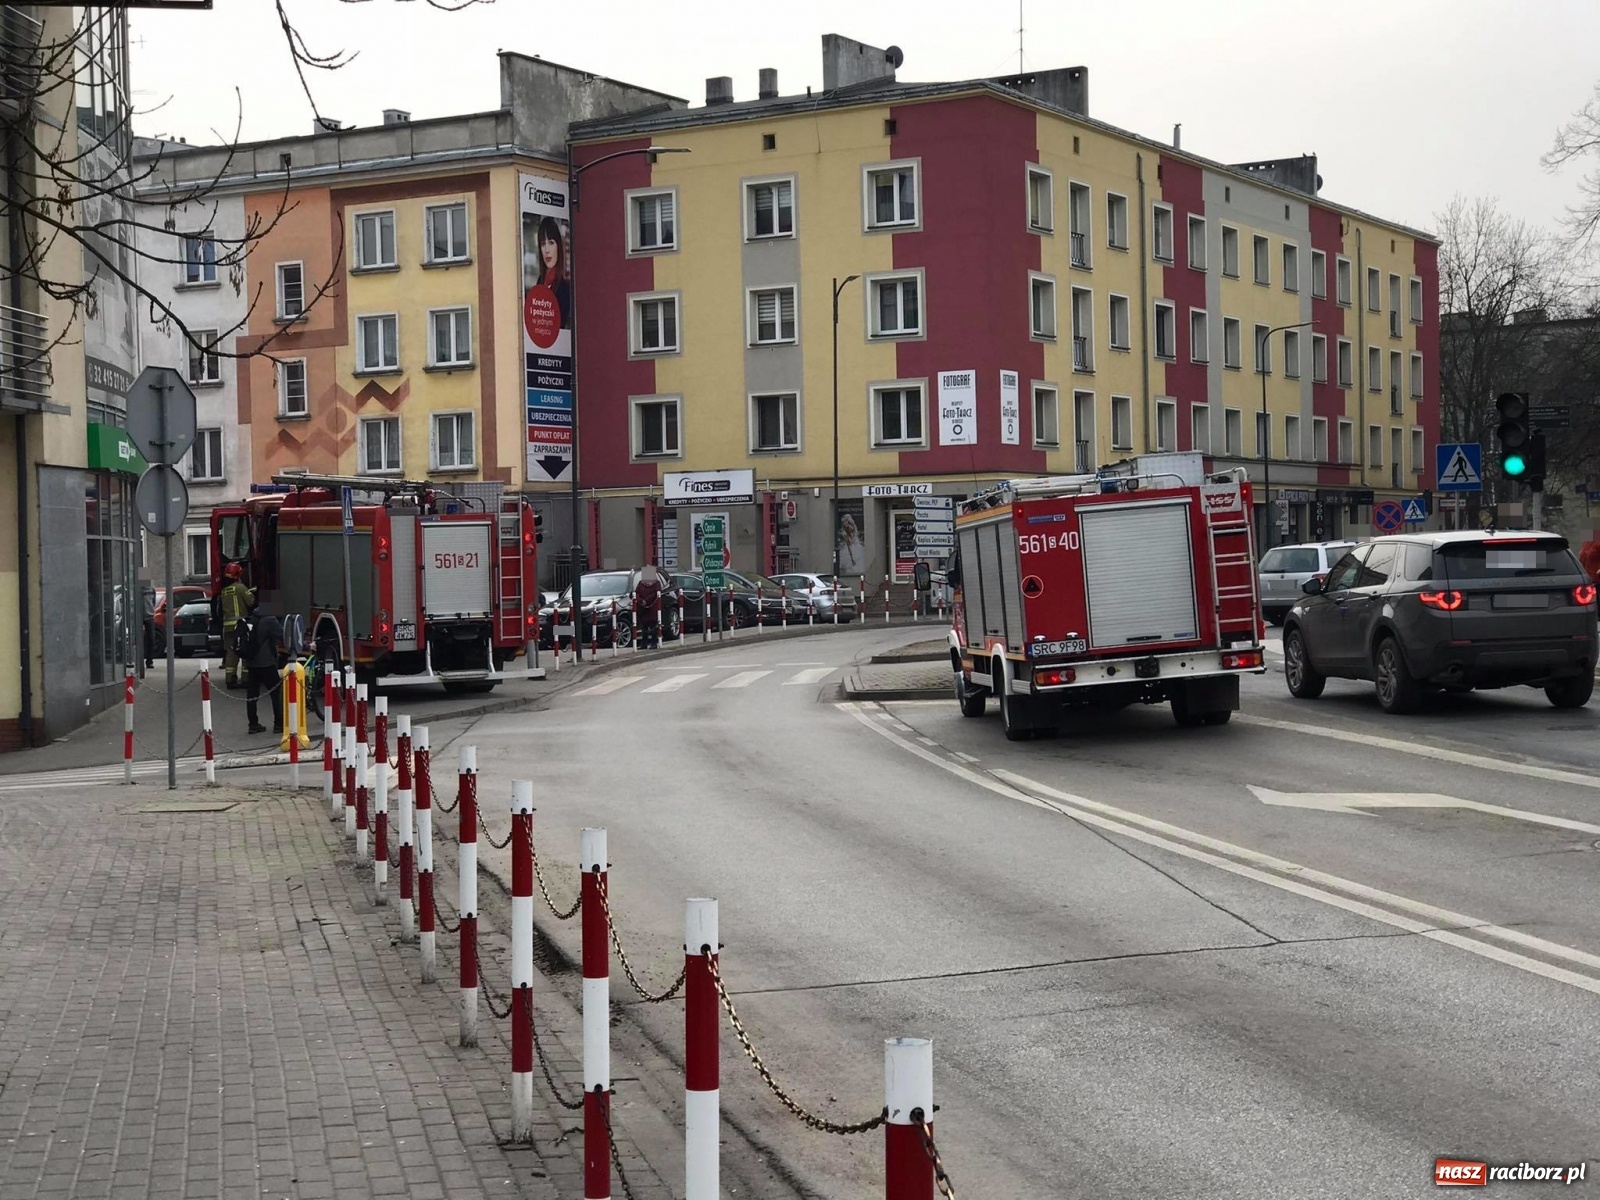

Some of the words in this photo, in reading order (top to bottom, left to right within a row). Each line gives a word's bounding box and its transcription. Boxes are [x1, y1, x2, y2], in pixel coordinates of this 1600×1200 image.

[529, 186, 552, 204] Fines
[532, 298, 552, 308] Kredyty
[533, 309, 555, 317] pożyczki
[538, 319, 554, 327] jednym
[538, 358, 562, 368] KREDYTY
[94, 365, 102, 384] 32
[103, 368, 113, 388] 415
[538, 376, 564, 386] POŻYCZKI
[943, 374, 971, 387] FOTOGRAF
[541, 394, 563, 404] LEASING
[531, 411, 572, 422] UBEZPIECZENIA
[534, 430, 552, 439] PUNKT
[553, 431, 570, 440] OPŁAT
[534, 444, 571, 454] ZAPRASZAMY
[684, 481, 713, 492] Fines
[705, 522, 716, 533] Opole
[705, 540, 717, 551] Rybnik
[1033, 643, 1057, 655] SRC
[1059, 640, 1085, 653] 9F98
